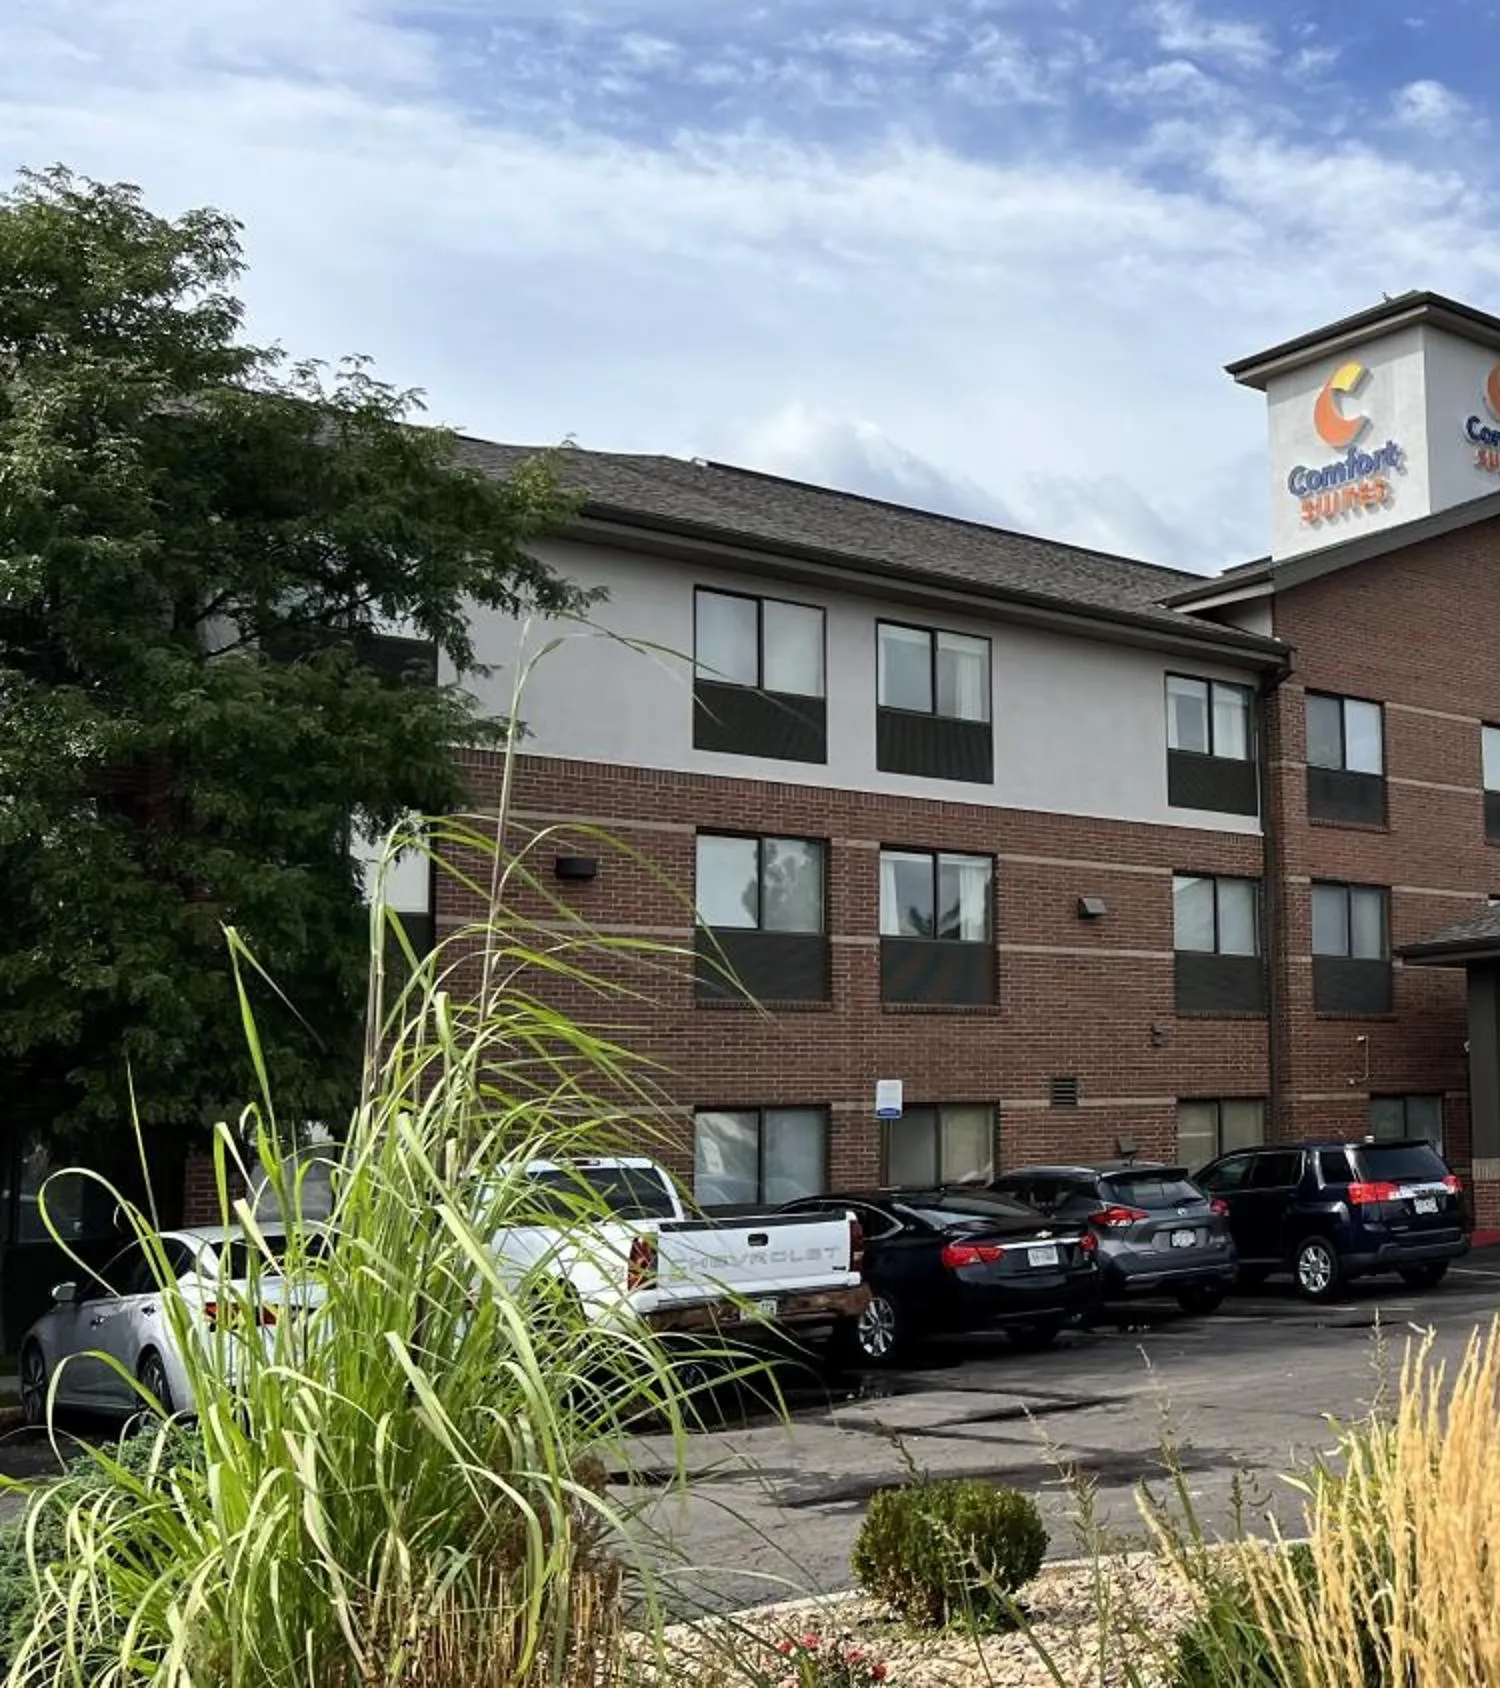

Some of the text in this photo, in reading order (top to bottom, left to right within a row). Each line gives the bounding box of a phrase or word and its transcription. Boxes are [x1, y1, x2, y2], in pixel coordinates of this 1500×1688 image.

[1287, 440, 1402, 497] Comfort
[1300, 478, 1387, 522] SUITES
[672, 1246, 841, 1270] CHEVROLET
